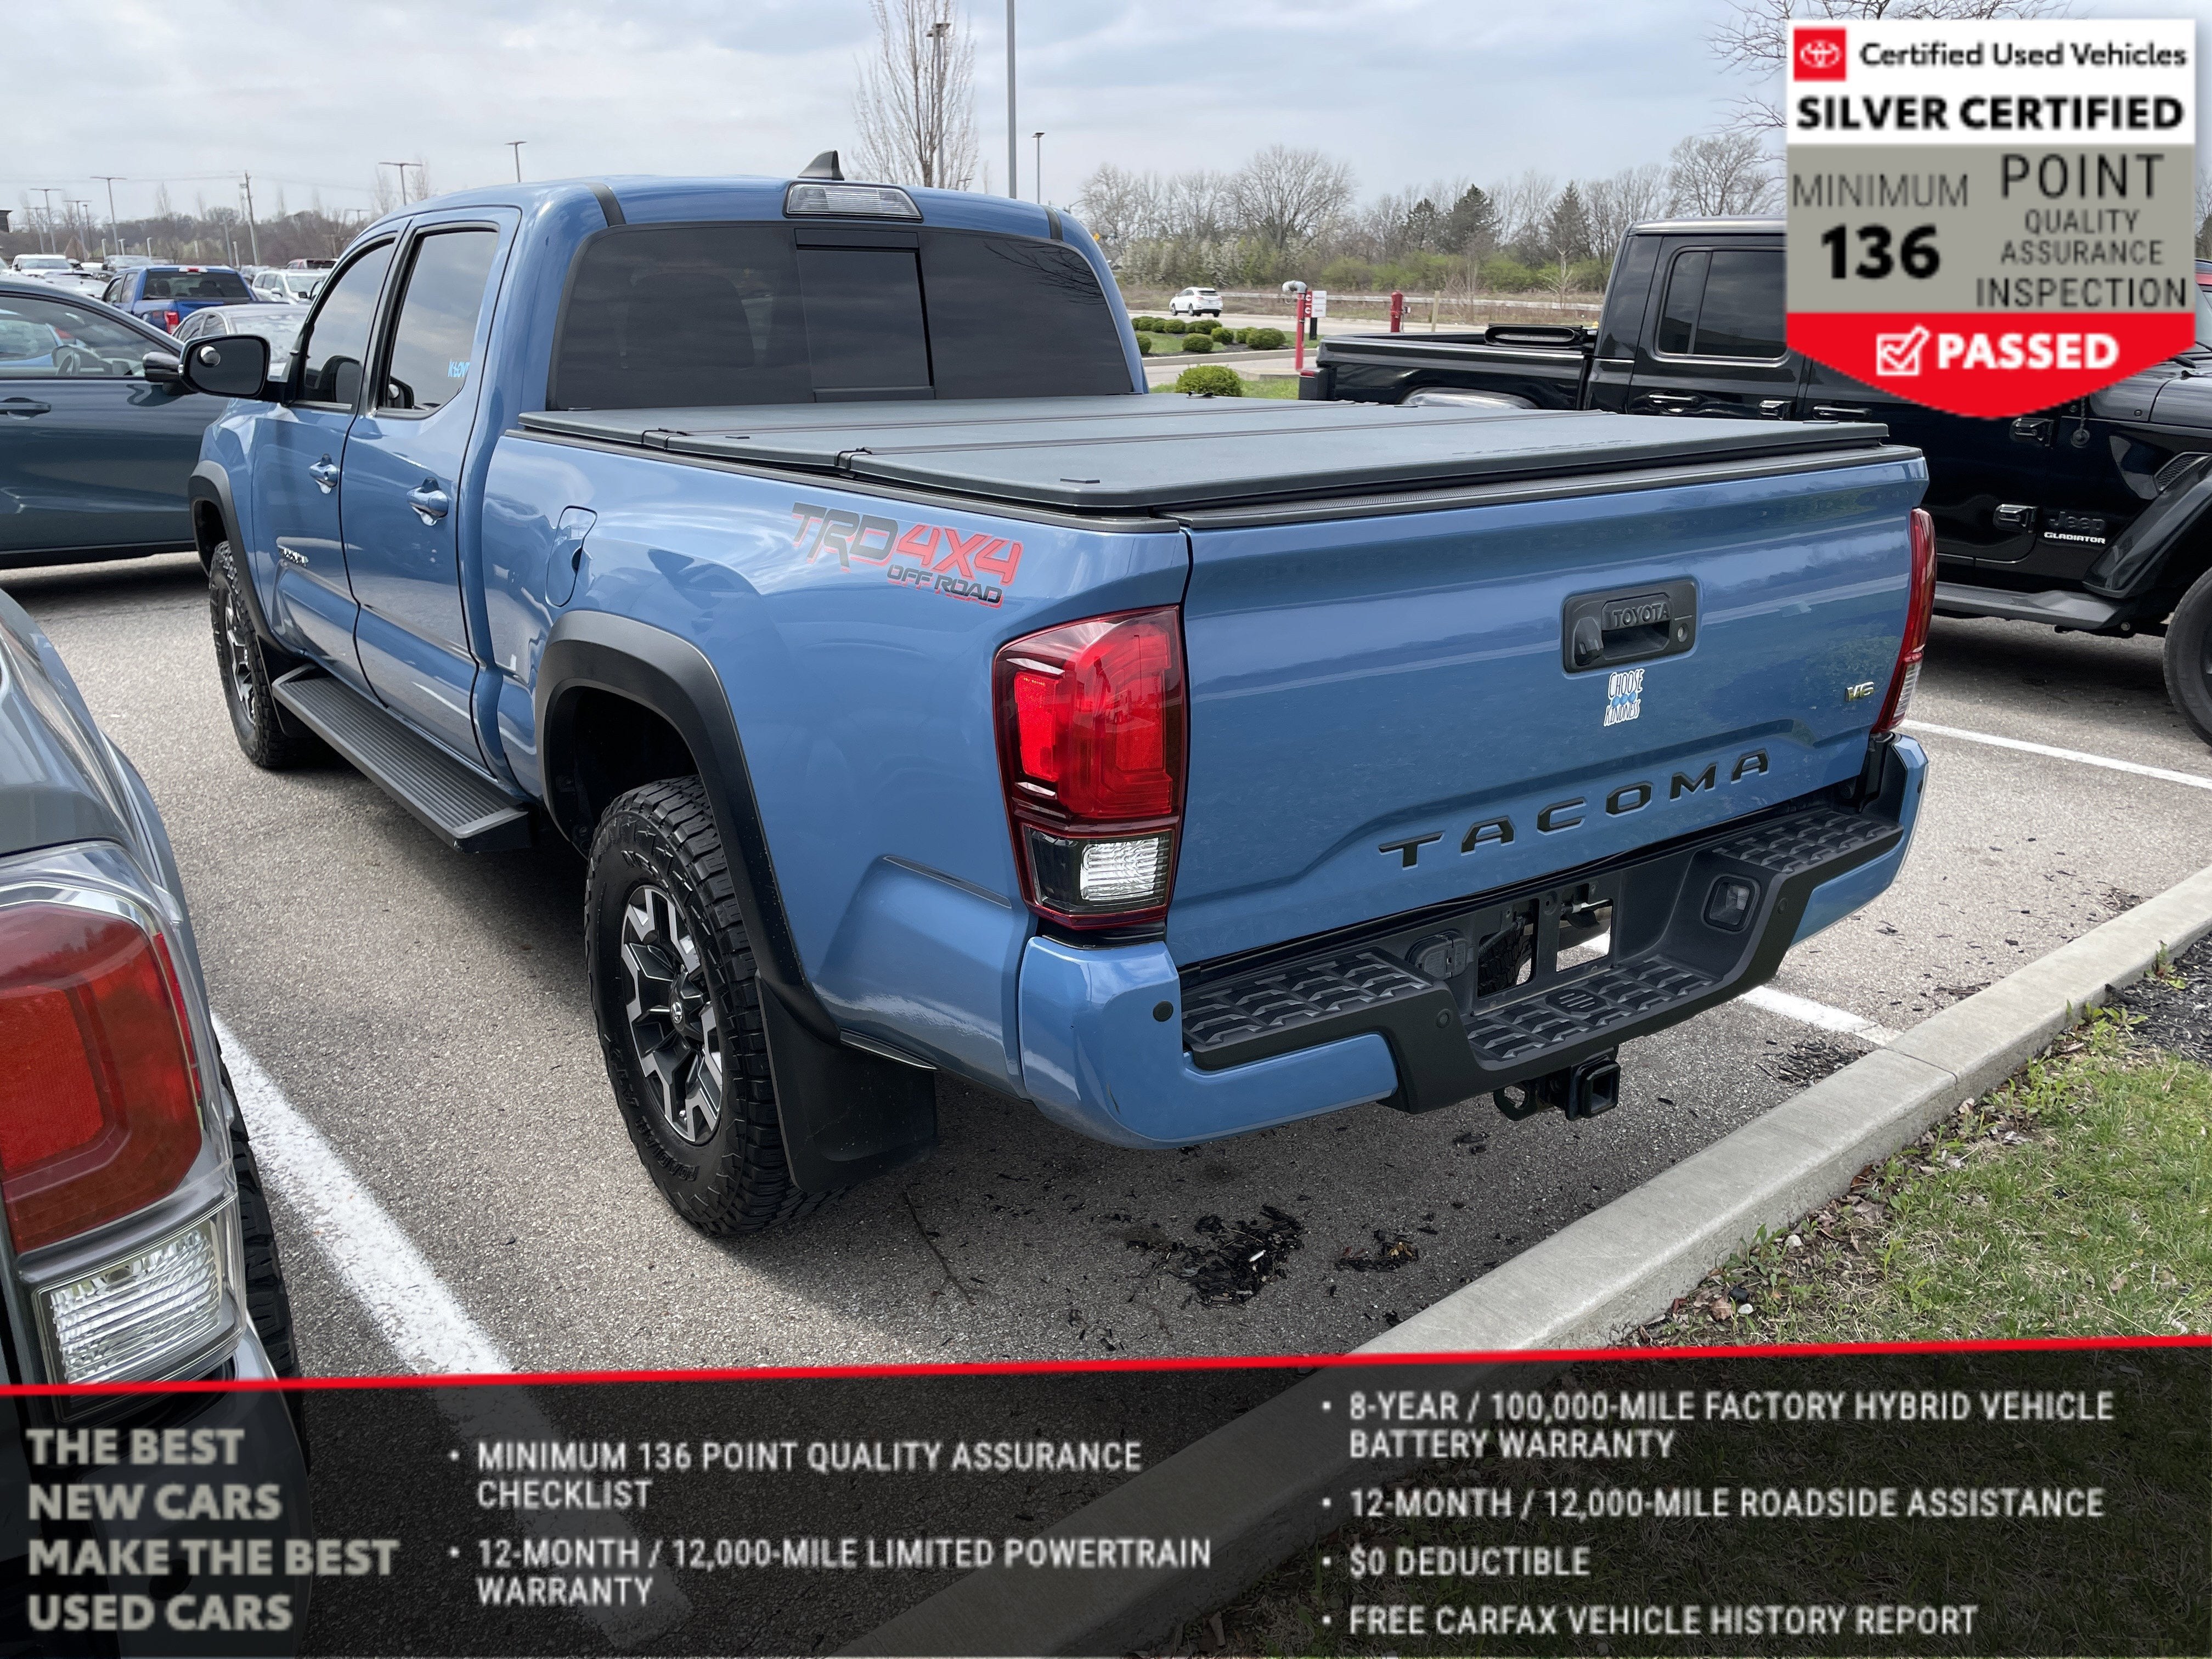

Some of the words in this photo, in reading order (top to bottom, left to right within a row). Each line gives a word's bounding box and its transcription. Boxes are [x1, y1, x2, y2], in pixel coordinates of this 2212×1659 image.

[2049, 511, 2106, 534] Jeep
[791, 501, 899, 573] TRD
[2044, 531, 2106, 545] GLADIATOR
[887, 563, 934, 590] OFF
[934, 574, 1005, 610] ROAD
[1612, 602, 1671, 627] TOYOTA
[1609, 669, 1644, 698] CHOOSE
[1844, 681, 1875, 702] V6
[1604, 700, 1640, 726] KINDNESS
[1378, 748, 1769, 869] TACOMA
